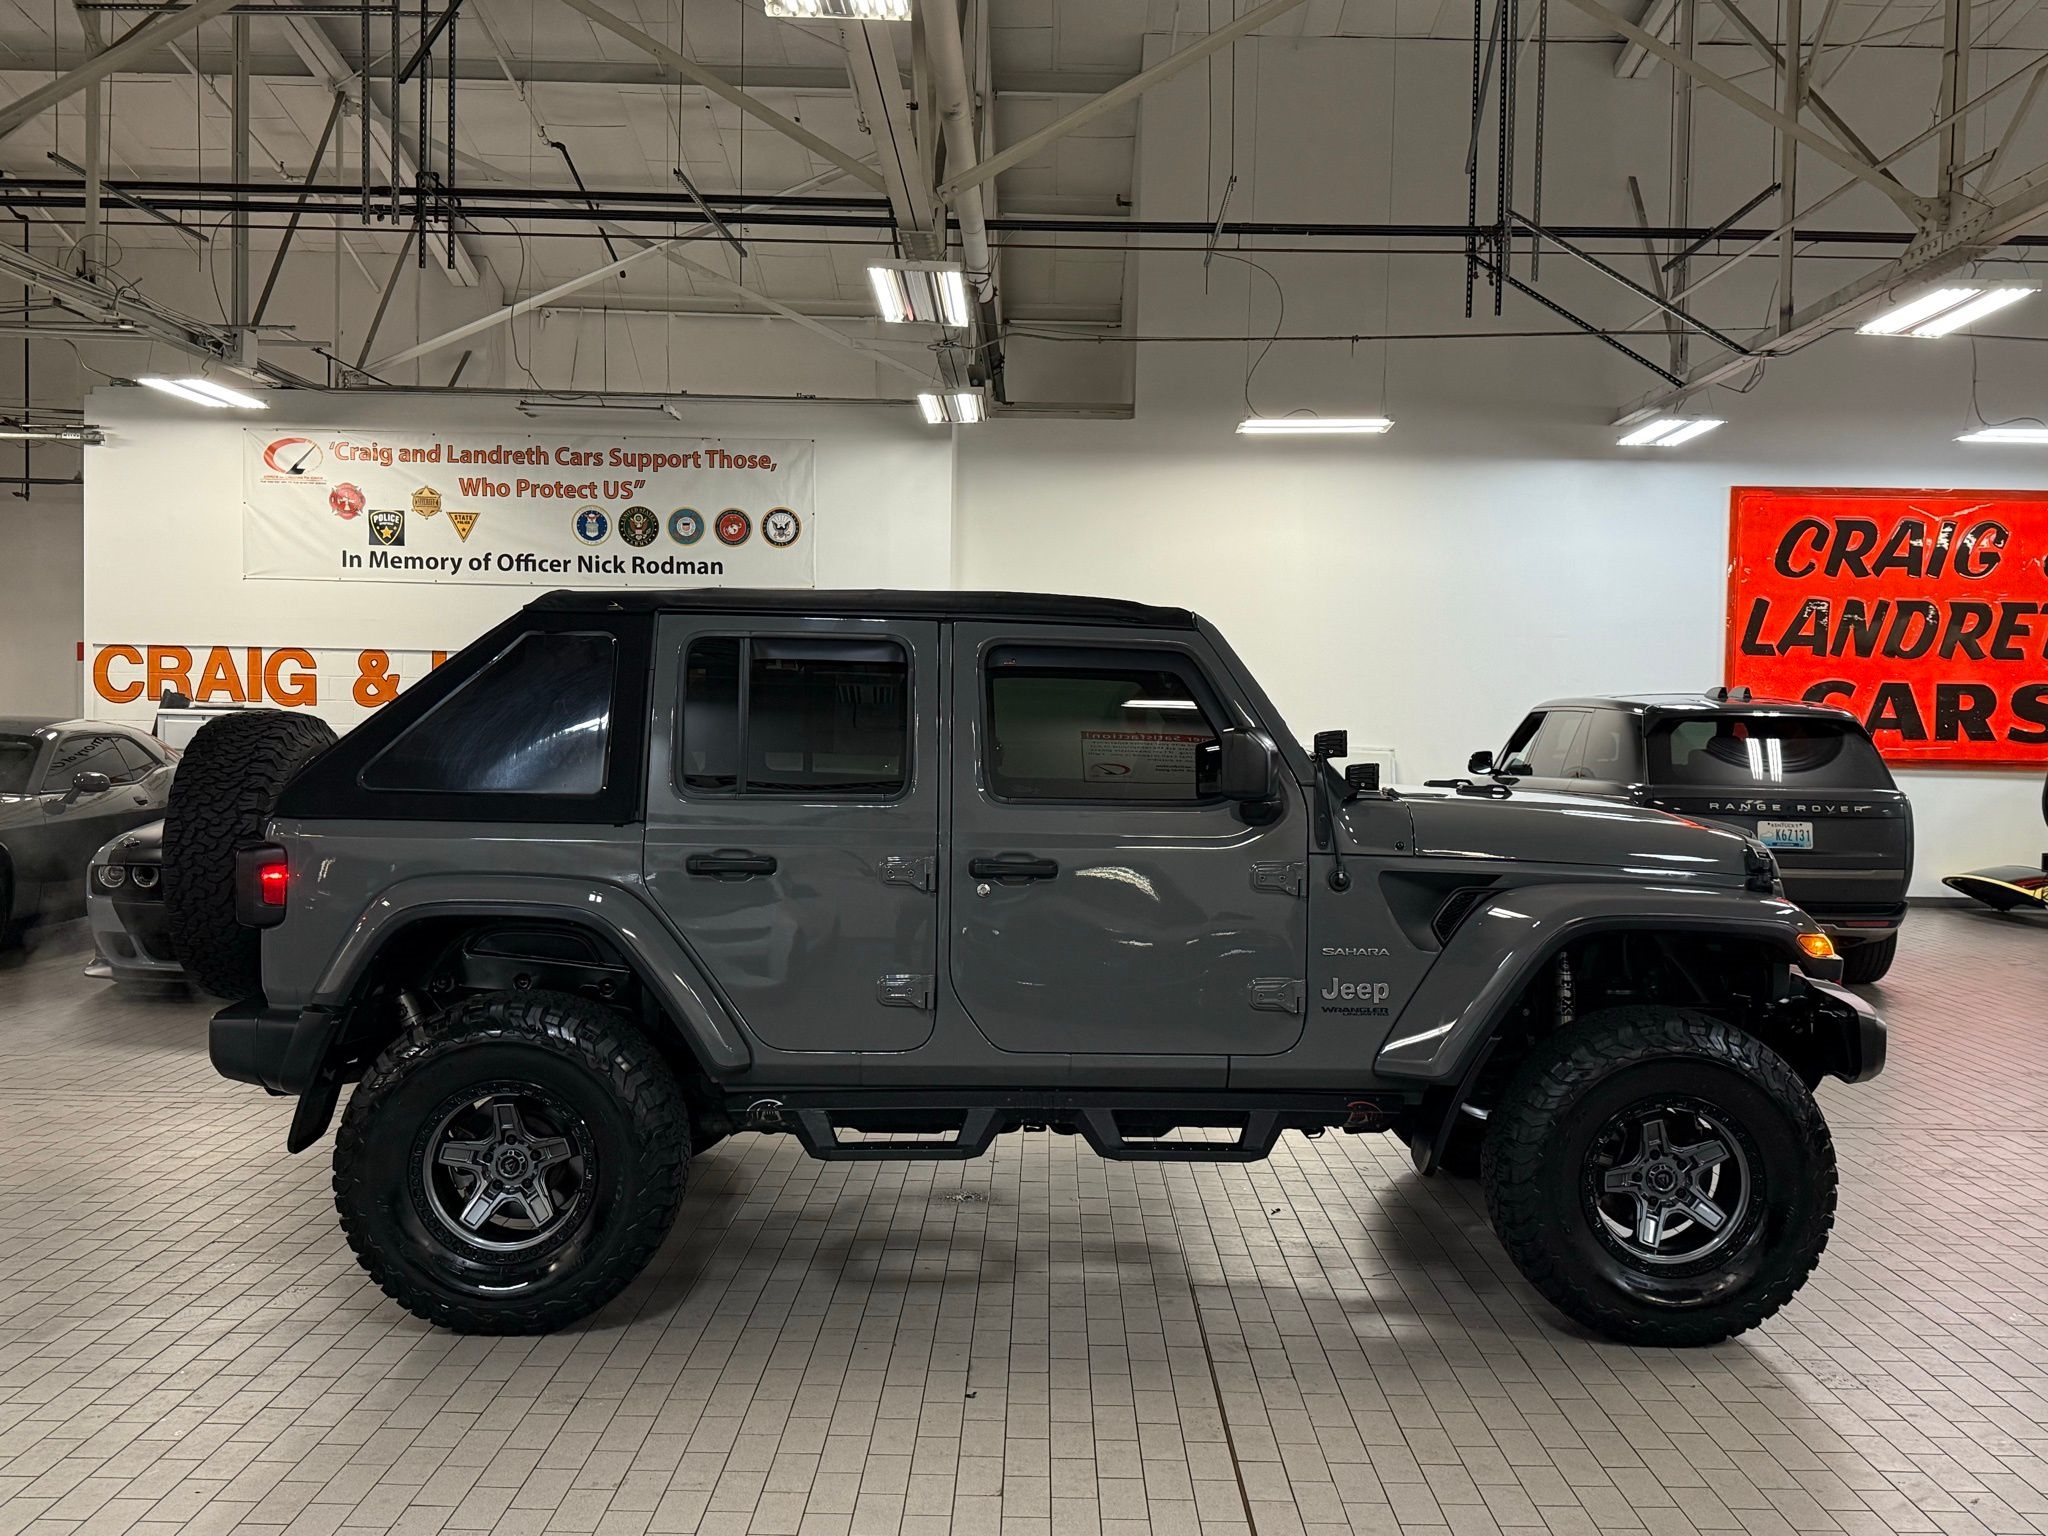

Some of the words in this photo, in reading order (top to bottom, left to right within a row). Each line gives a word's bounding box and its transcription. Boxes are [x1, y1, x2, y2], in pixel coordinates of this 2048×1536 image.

[399, 444, 441, 464] and
[447, 444, 550, 465] Landreth
[554, 447, 604, 467] Cars
[608, 447, 701, 472] Support
[705, 449, 778, 471] Those,
[458, 477, 512, 497] Who
[516, 478, 598, 499] Protect
[373, 513, 400, 524] POLICE
[1774, 517, 2010, 579] CRAIG
[342, 550, 362, 568] In
[369, 550, 462, 575] Memory
[468, 552, 492, 571] of
[496, 553, 572, 573] Officer
[577, 555, 626, 574] Nick
[631, 556, 724, 575] Rodman
[1740, 597, 2048, 660] LANDRE
[93, 643, 318, 707] CRAIG
[352, 648, 401, 708] &
[1709, 801, 1782, 812] RANGE
[1796, 804, 1864, 813] ROVER
[1775, 828, 1811, 842] K6Z131
[1322, 947, 1391, 956] SAHARA
[1321, 977, 1390, 1004] Jeep
[1321, 1006, 1389, 1014] WRANGLER
